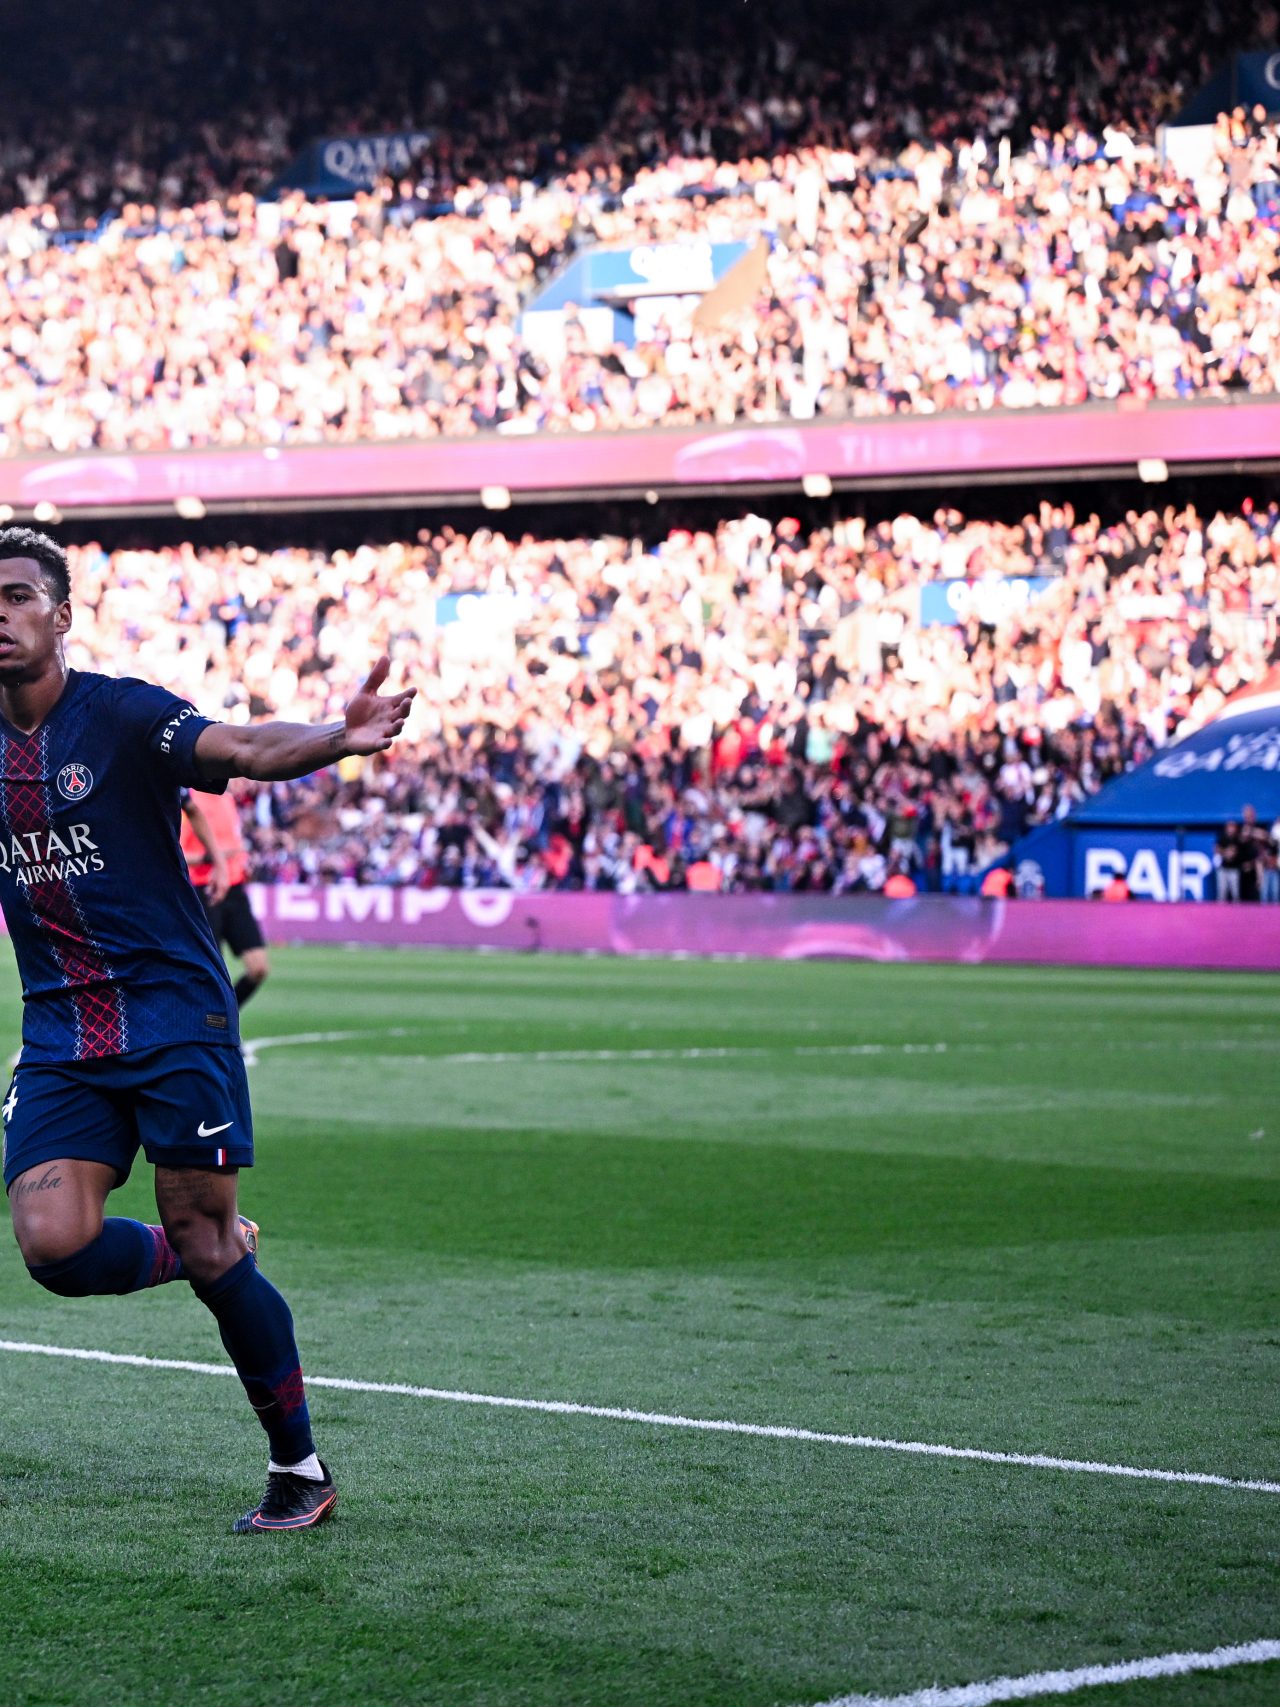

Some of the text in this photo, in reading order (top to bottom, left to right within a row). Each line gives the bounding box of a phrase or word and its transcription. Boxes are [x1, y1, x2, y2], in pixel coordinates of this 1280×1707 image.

[61, 765, 85, 777] PARIS
[15, 852, 105, 887] AIRWAYS
[244, 882, 516, 928] IEMPO
